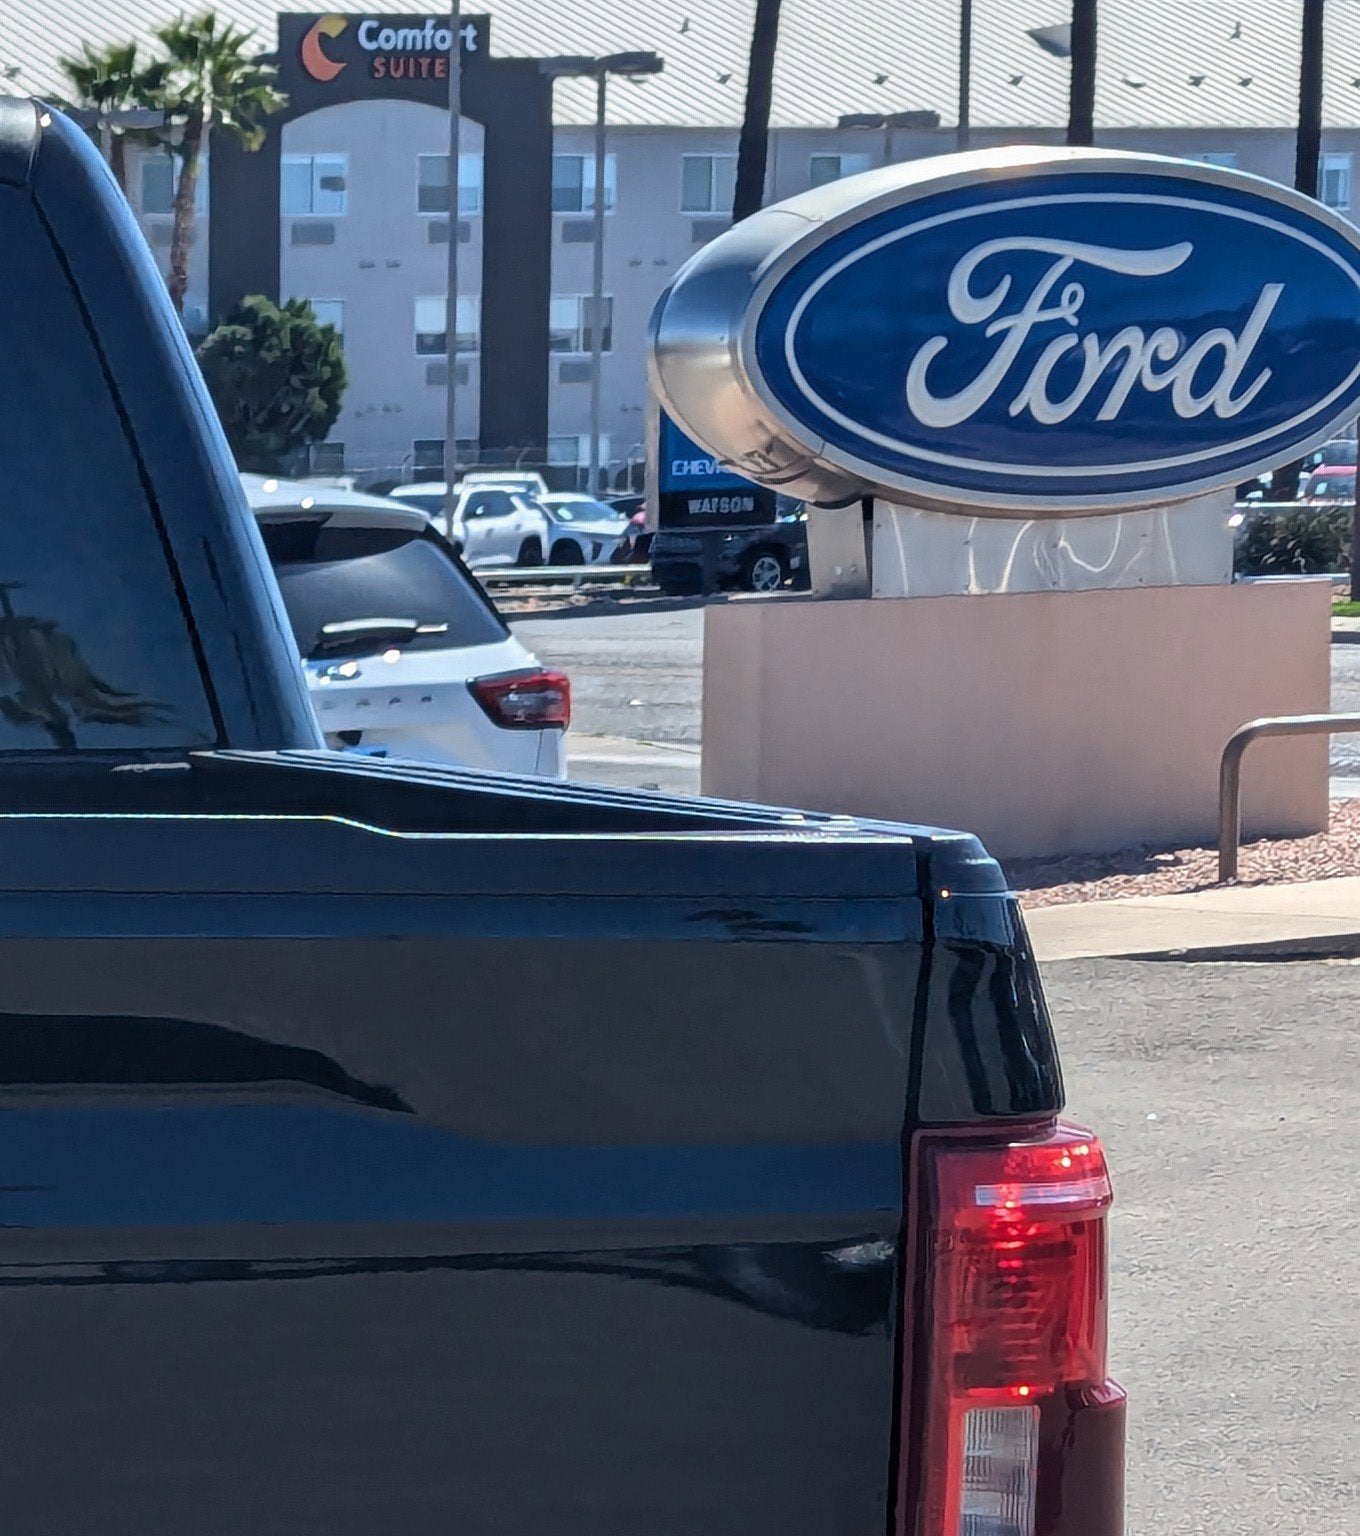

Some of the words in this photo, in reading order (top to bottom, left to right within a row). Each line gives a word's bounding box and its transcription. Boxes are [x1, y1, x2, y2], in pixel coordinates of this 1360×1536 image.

[374, 56, 460, 79] SUITE
[906, 236, 1286, 428] Ford
[671, 459, 727, 476] CHEV
[688, 496, 755, 515] WATSON
